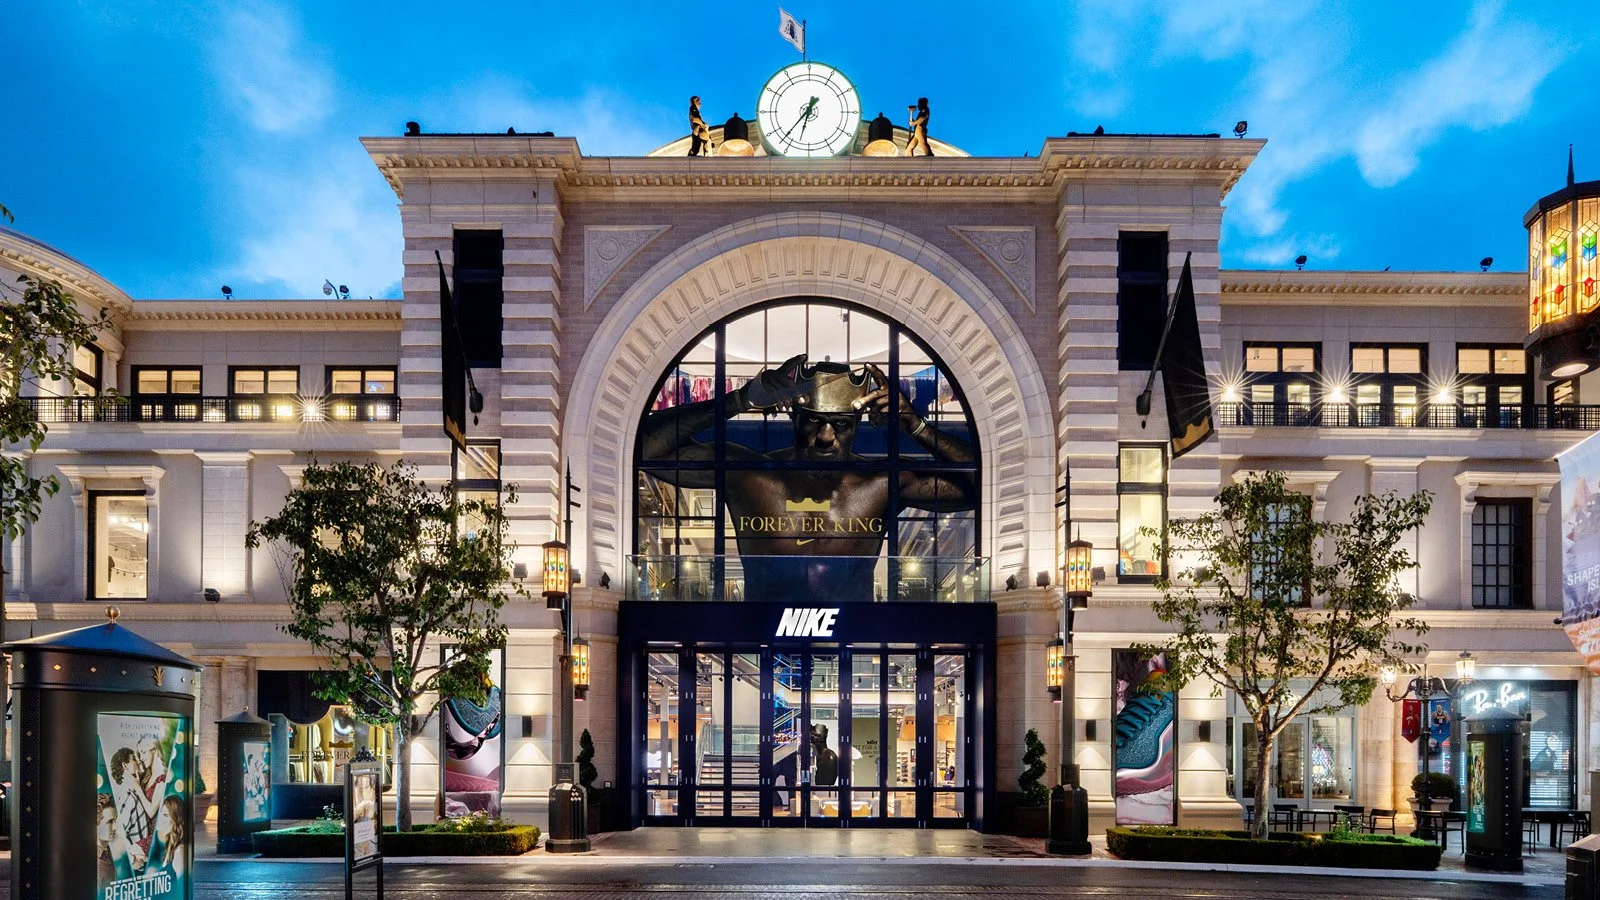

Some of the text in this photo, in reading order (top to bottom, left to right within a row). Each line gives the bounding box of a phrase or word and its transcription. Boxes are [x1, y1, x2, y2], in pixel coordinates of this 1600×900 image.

[740, 516, 883, 532] FOREVER KING
[1567, 564, 1600, 586] SHAPE
[775, 607, 840, 637] NIKE
[105, 875, 171, 900] REGRETTING
